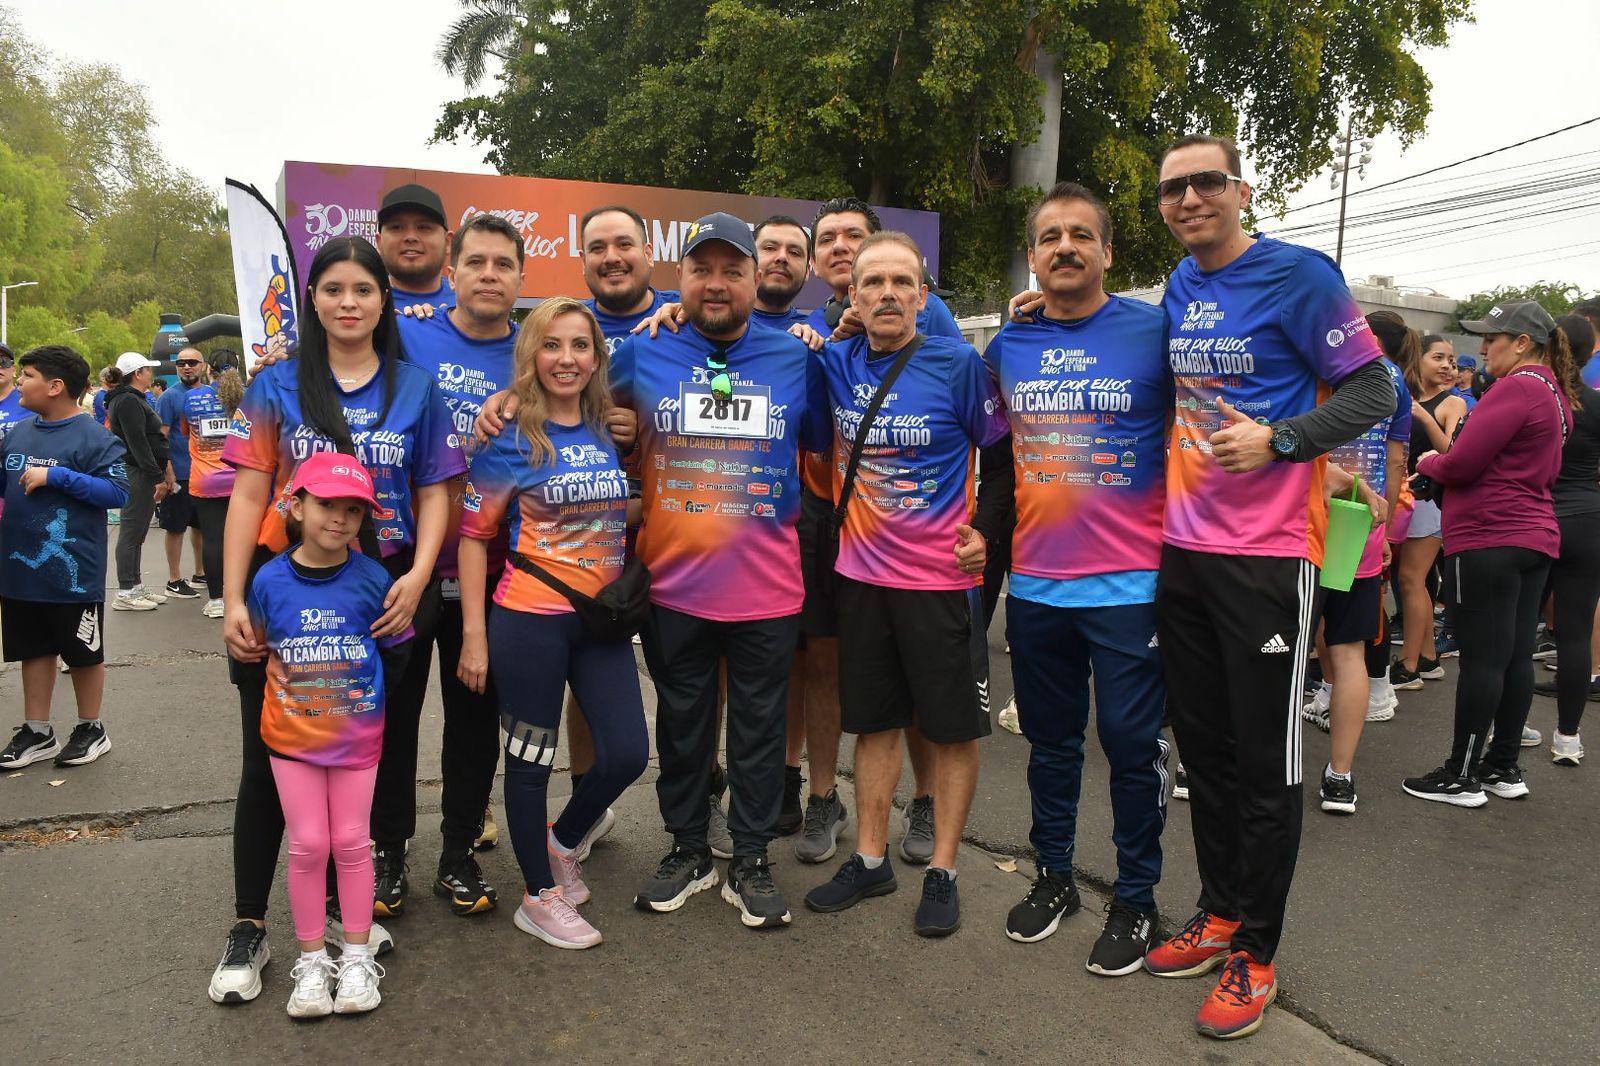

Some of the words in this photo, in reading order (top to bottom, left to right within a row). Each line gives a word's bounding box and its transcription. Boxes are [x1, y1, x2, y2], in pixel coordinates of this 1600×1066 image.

[348, 208, 377, 222] DANDO
[568, 213, 581, 257] L
[521, 234, 565, 259] LLOS
[1189, 338, 1216, 353] POR
[1214, 336, 1253, 353] ELLOS
[1041, 348, 1065, 367] 50
[1066, 356, 1098, 364] ESPERANZA
[1169, 352, 1214, 374] CAMBIA
[1213, 352, 1255, 374] TODO
[466, 368, 484, 380] DANDO
[1039, 364, 1064, 375] AÑOS
[464, 376, 497, 391] ESPERANZA
[464, 384, 472, 394] DE
[474, 388, 486, 396] VIDA
[1015, 379, 1059, 394] CORRER
[1057, 379, 1090, 394] POR
[1090, 377, 1132, 392] ELLOS
[699, 397, 752, 421] 2817
[1025, 391, 1085, 412] CAMBIA
[1087, 391, 1132, 412] TODO
[208, 419, 228, 430] 1971
[654, 412, 673, 433] LO
[892, 415, 930, 428] ELLOS
[1037, 414, 1070, 424] CARRERA
[371, 429, 405, 447] ELLOS
[667, 435, 688, 448] GRAN
[690, 437, 726, 450] CARRERA
[728, 439, 773, 453] GANAC-TEC
[891, 427, 931, 446] TODO
[291, 439, 308, 460] LO
[369, 443, 405, 468] TODO
[548, 471, 594, 486] CORRER
[596, 469, 618, 481] POR
[543, 486, 564, 504] LO
[568, 480, 622, 503] CAMBIA
[560, 505, 579, 516] GRAN
[580, 501, 610, 513] CARRERA
[76, 609, 95, 644] NIKE
[280, 636, 319, 648] CORRER
[320, 635, 344, 646] POR
[1260, 645, 1290, 653] adidas
[294, 646, 341, 663] CAMBIA
[303, 663, 331, 673] CARRERA
